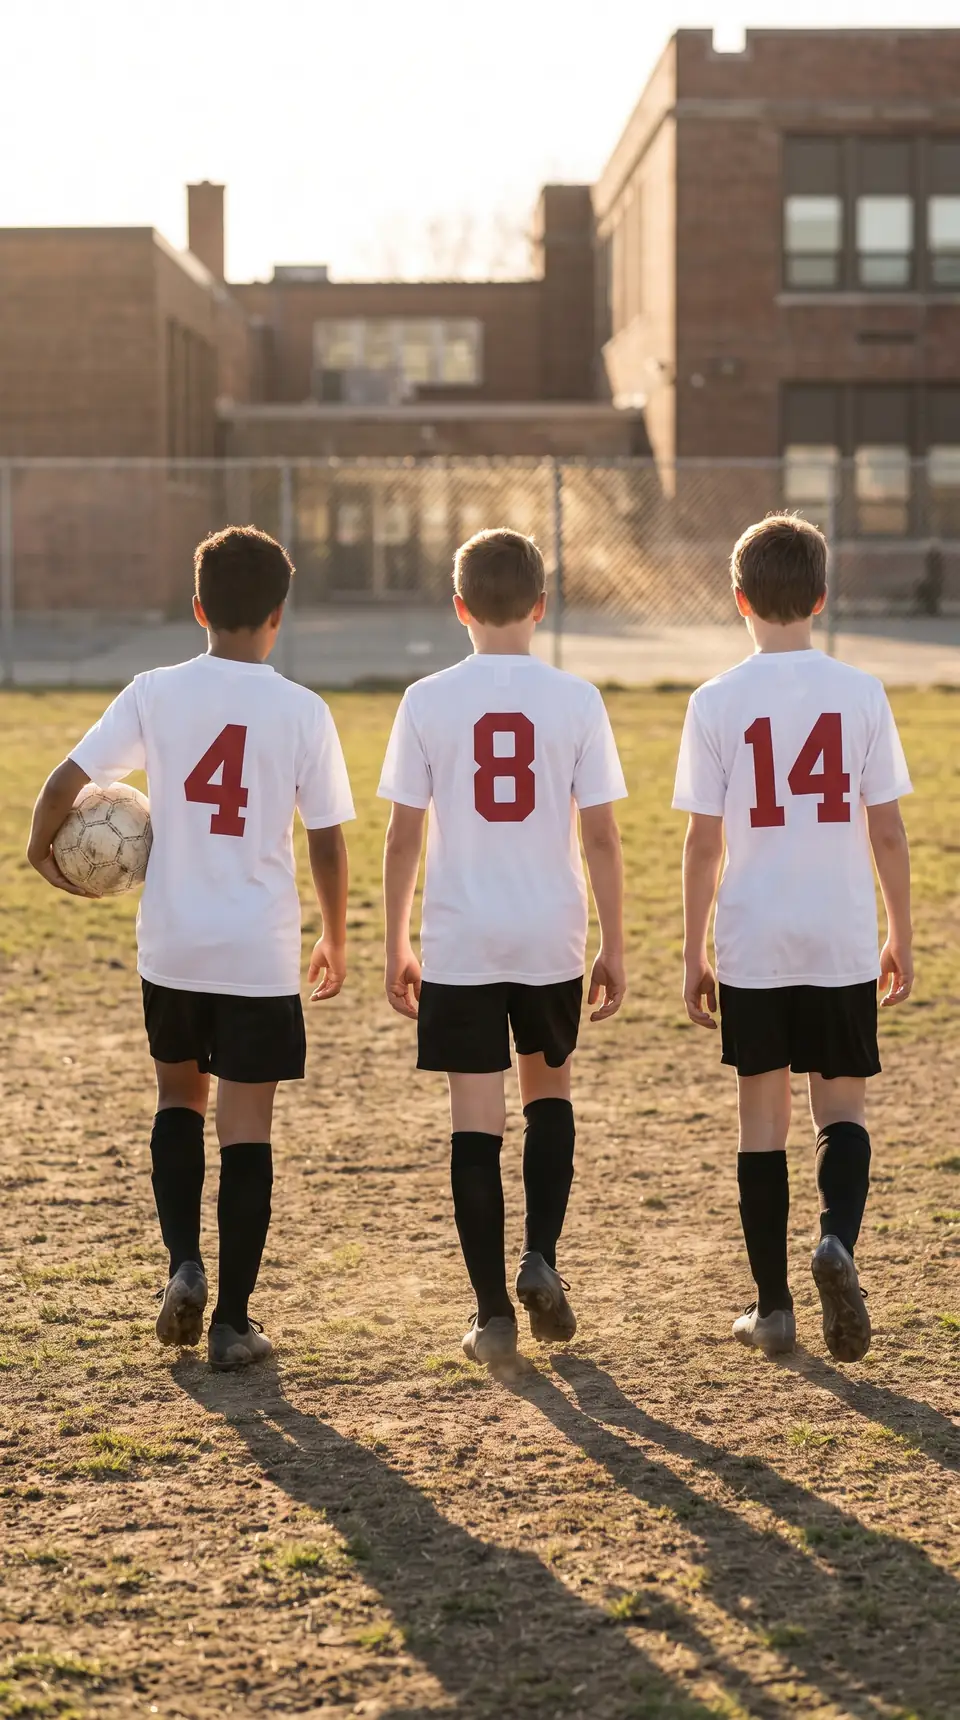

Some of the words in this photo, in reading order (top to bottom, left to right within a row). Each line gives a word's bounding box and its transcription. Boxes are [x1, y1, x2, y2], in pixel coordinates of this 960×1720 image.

[184, 723, 249, 837] 4
[473, 712, 536, 822] 8
[744, 712, 851, 828] 14
